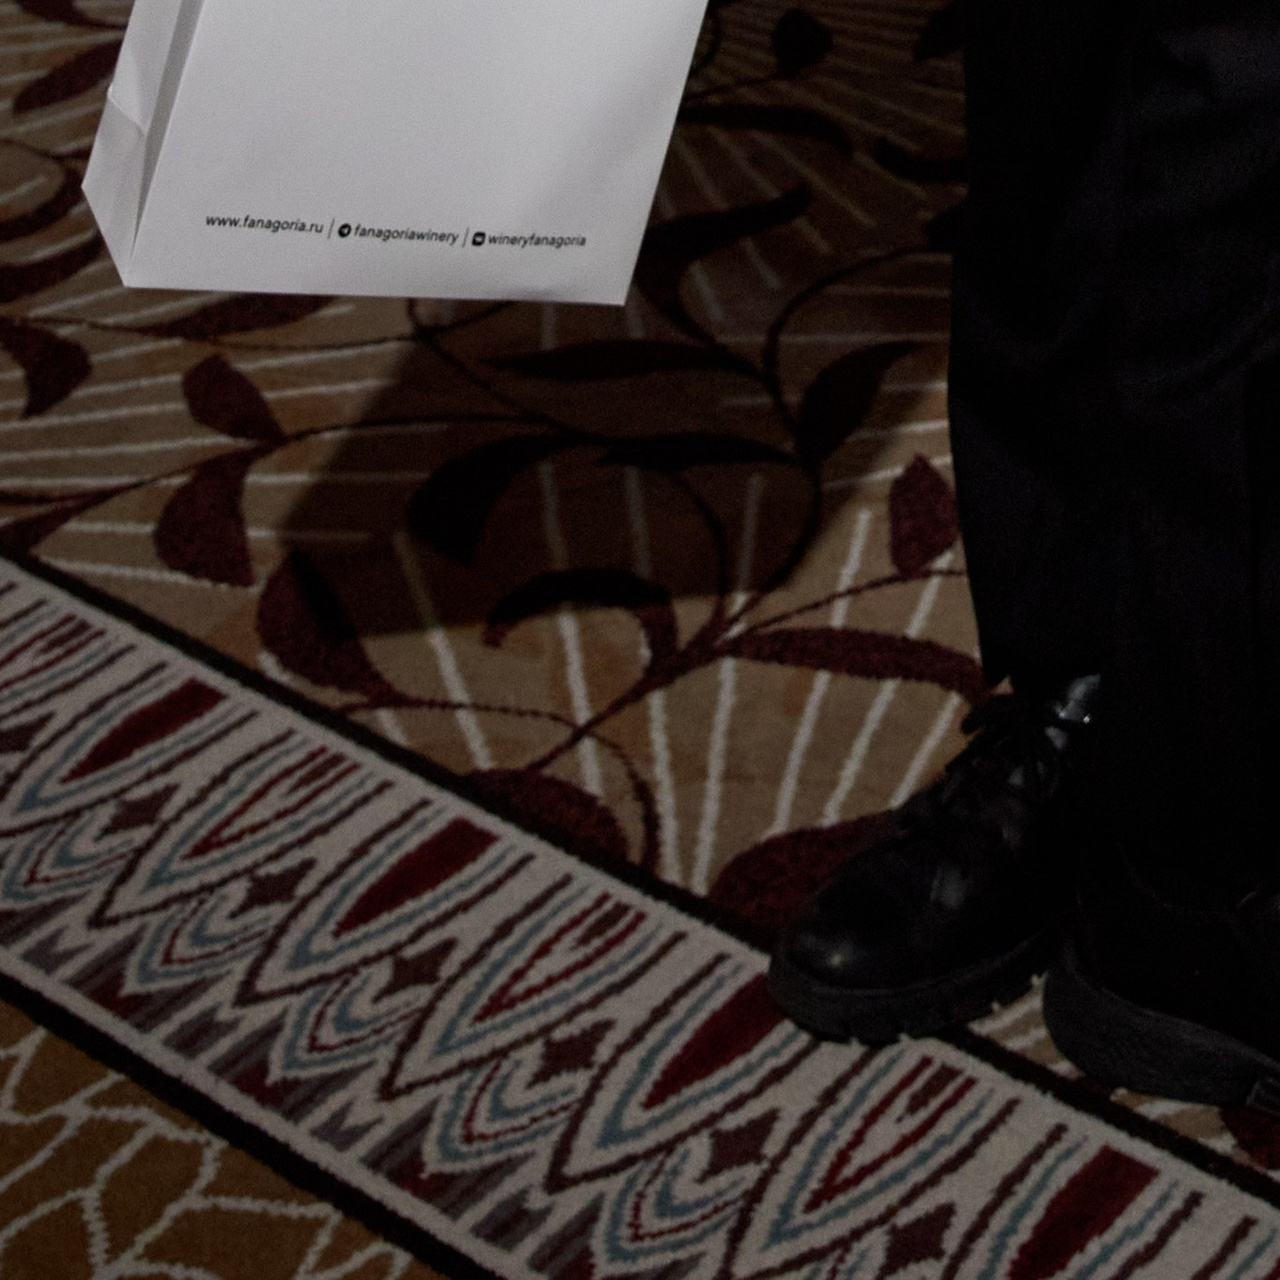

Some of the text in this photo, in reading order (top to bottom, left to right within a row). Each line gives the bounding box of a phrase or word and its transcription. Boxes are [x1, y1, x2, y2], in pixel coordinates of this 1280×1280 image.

[205, 214, 587, 249] www.fanagoria.ru fanagoriawinery wineryfanagoria
